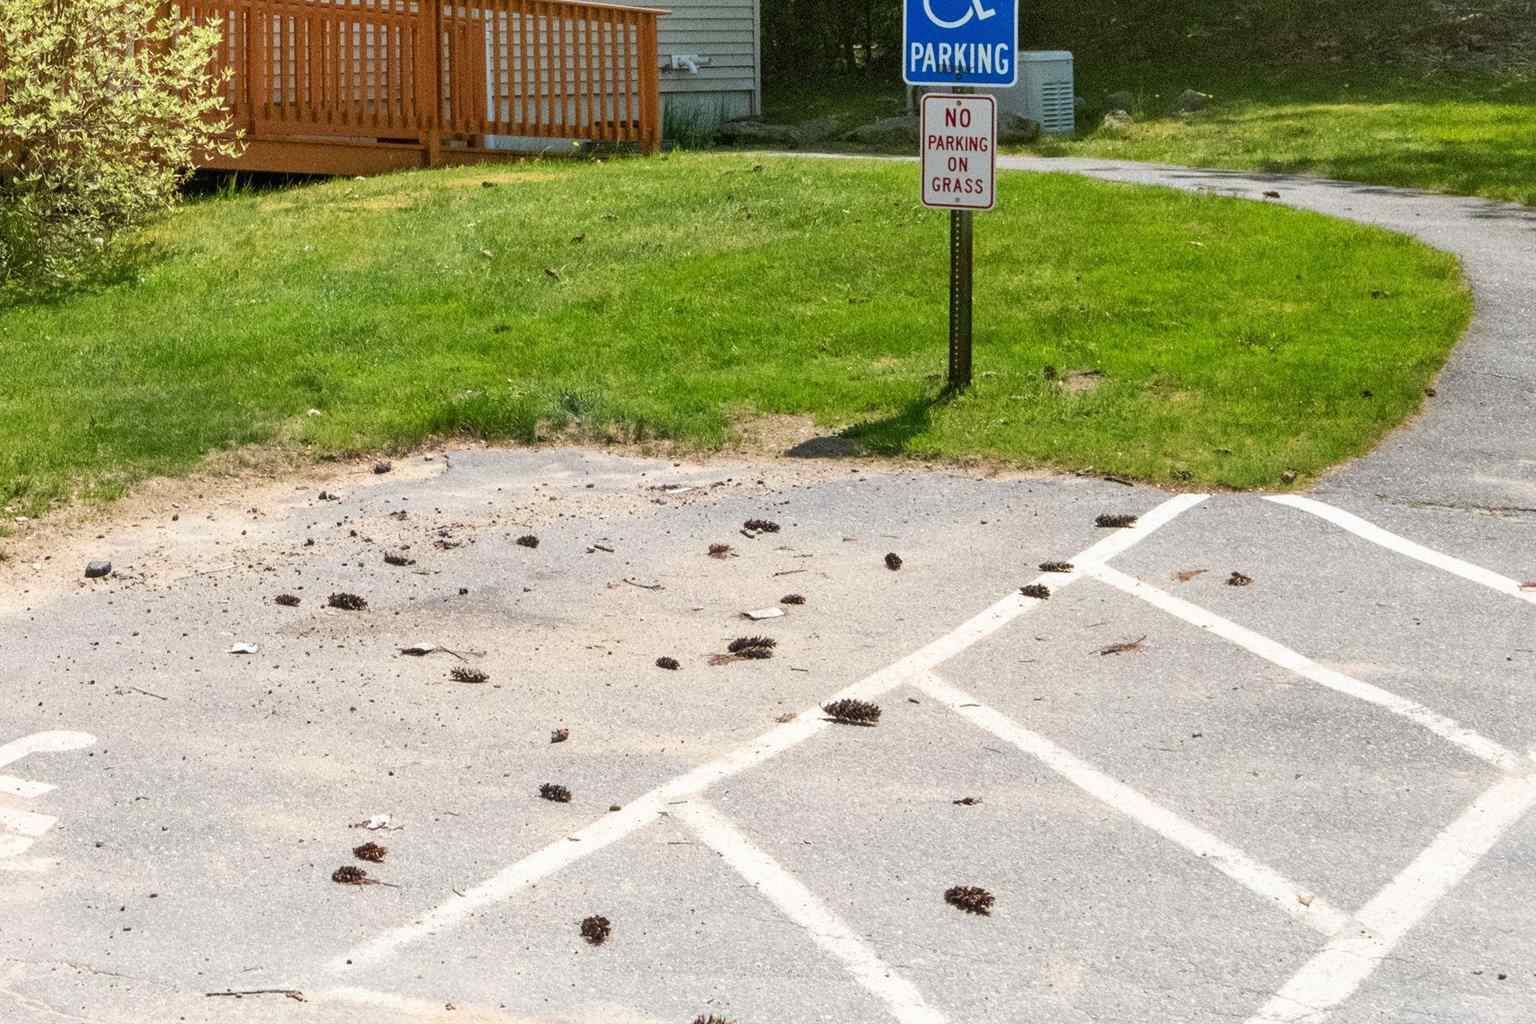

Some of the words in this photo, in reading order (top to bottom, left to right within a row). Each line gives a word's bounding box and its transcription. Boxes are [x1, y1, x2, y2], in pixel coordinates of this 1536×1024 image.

[911, 43, 1009, 75] PARKING
[945, 108, 971, 128] NO
[928, 135, 988, 152] PARKING
[948, 156, 968, 172] ON
[931, 177, 983, 194] GRASS
